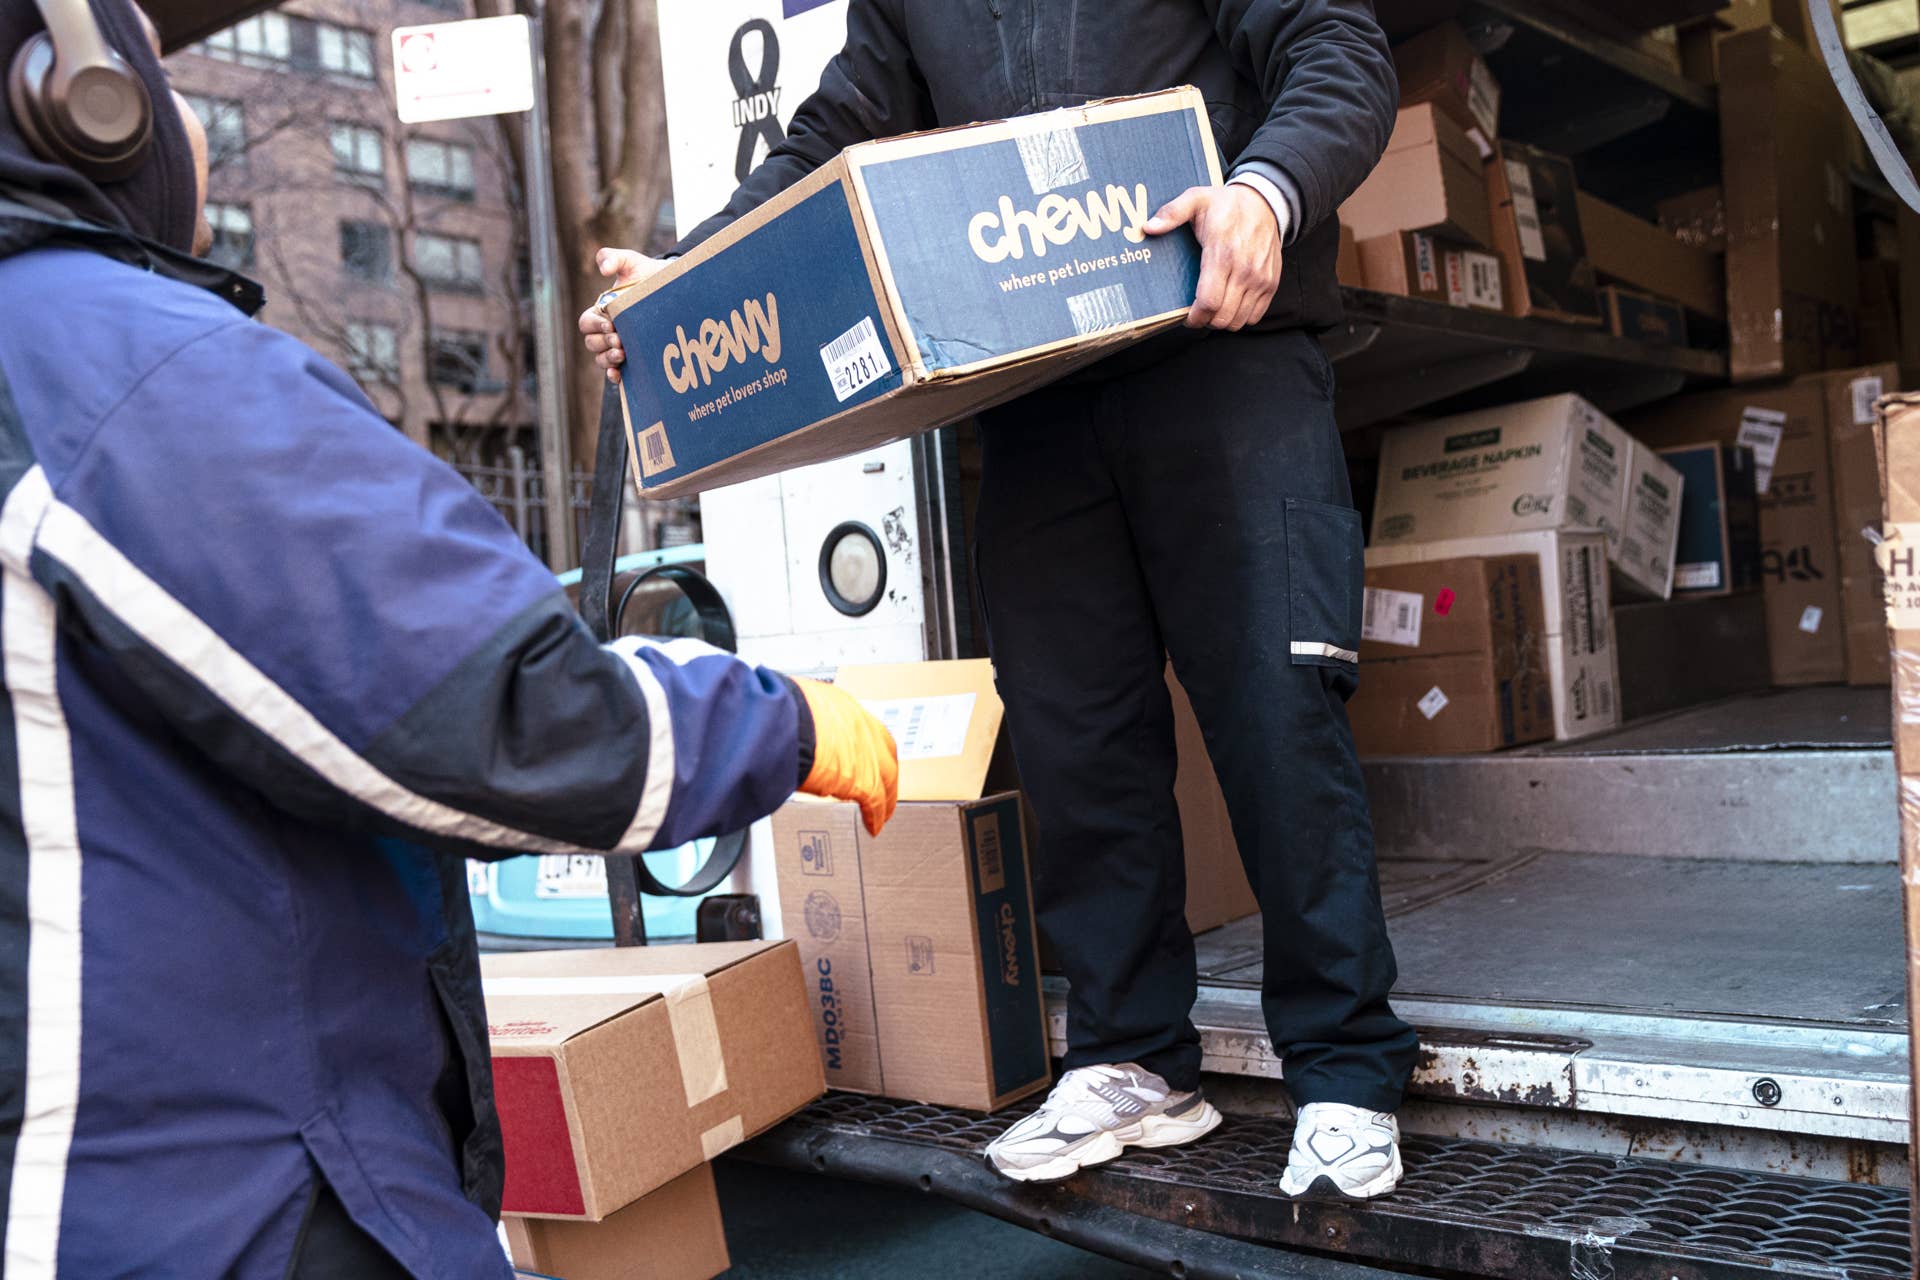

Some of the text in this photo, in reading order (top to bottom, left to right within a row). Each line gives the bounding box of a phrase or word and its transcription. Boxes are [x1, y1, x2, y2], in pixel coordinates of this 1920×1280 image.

[732, 87, 781, 127] INDY
[967, 183, 1148, 264] chewy
[999, 247, 1152, 292] where pet lovers shop
[663, 292, 781, 394] chewy
[688, 367, 788, 423] where pet lovers shop
[1402, 454, 1479, 481] BEVERAGE
[1482, 443, 1542, 465] NAPKIN
[1001, 902, 1020, 987] chewy
